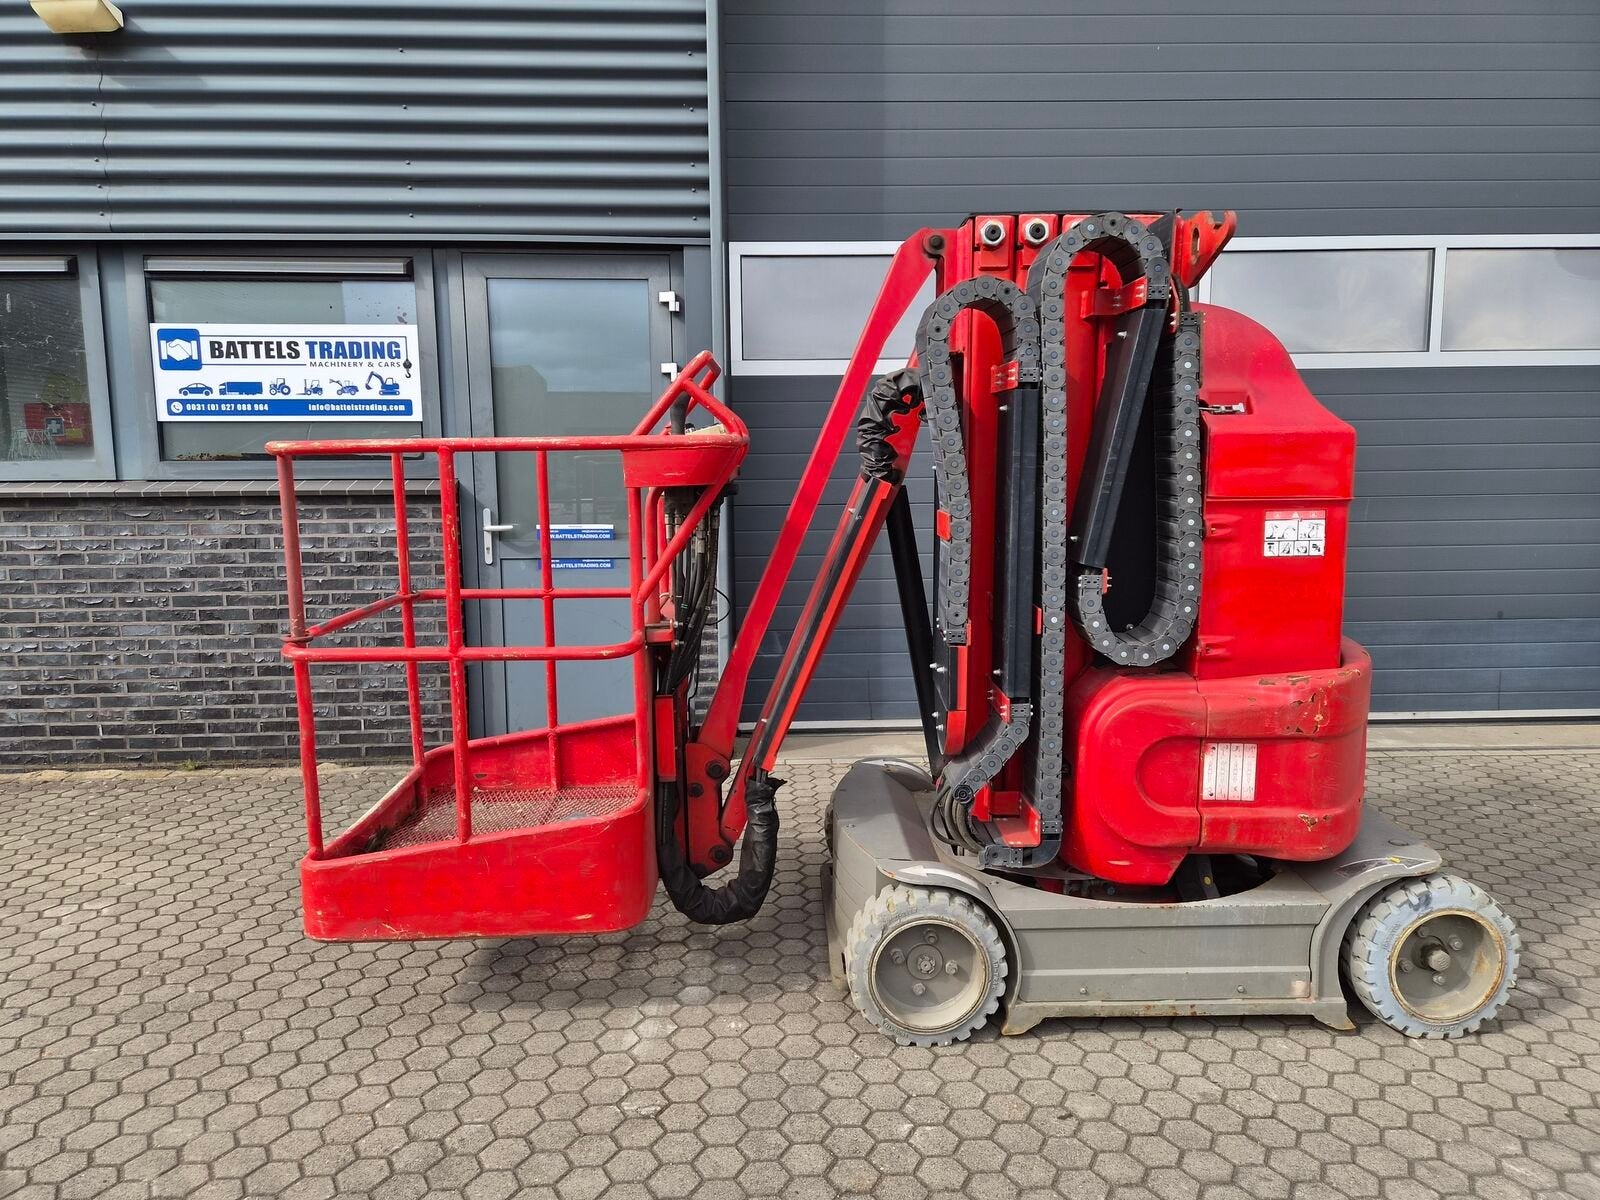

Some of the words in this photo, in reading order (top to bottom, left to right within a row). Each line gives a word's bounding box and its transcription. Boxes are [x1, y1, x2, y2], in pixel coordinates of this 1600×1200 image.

[209, 340, 300, 360] BATTELS
[304, 340, 401, 360] TRADING
[186, 403, 206, 411] 0031
[207, 403, 219, 411] (0)
[308, 403, 406, 412] info@battelstrading.com
